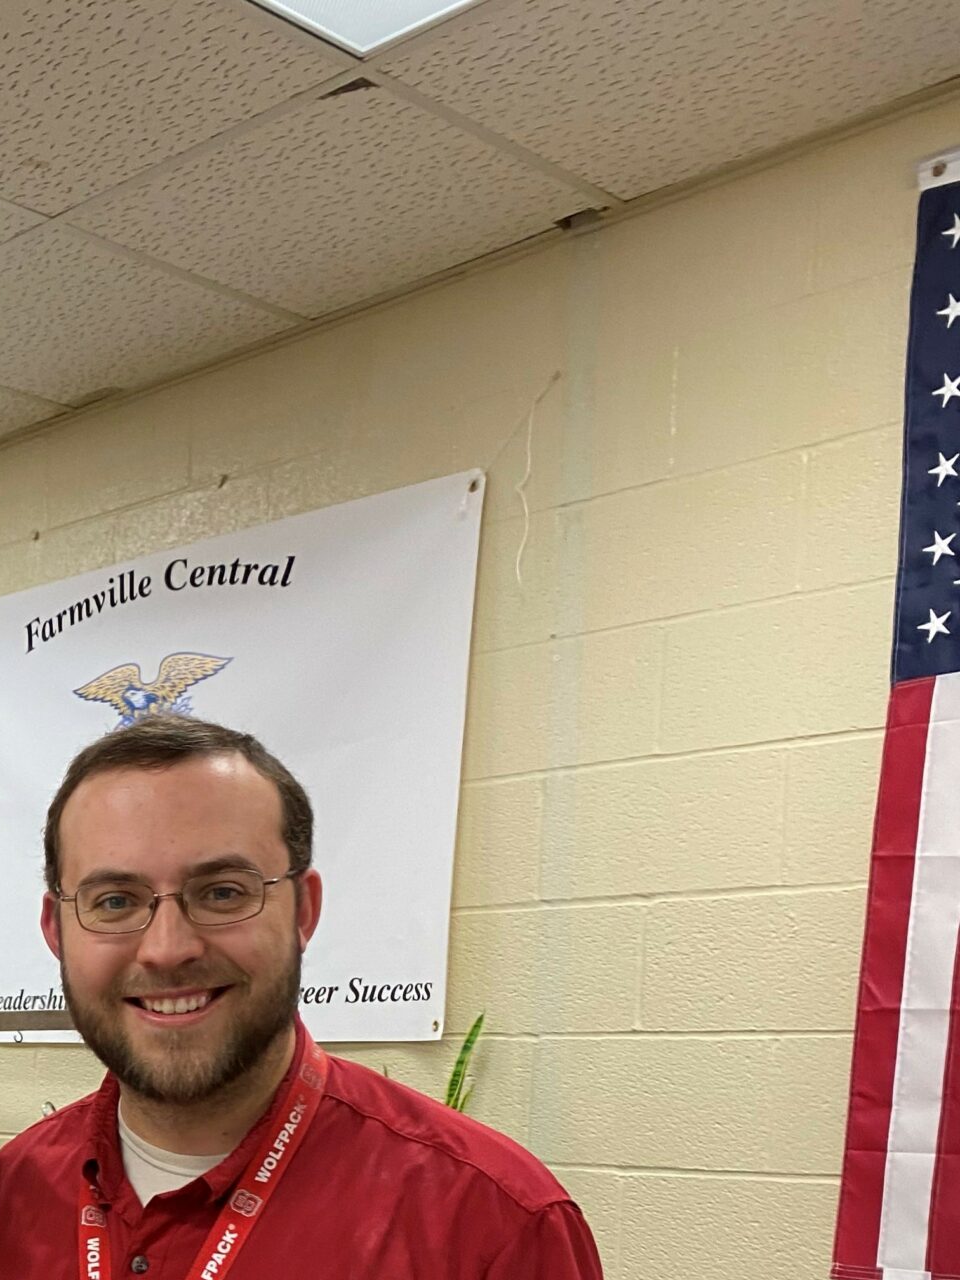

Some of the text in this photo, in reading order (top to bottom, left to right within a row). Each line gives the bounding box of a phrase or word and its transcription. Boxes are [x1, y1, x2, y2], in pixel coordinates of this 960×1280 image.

[25, 556, 296, 654] Farmville Central
[345, 977, 433, 1004] Success
